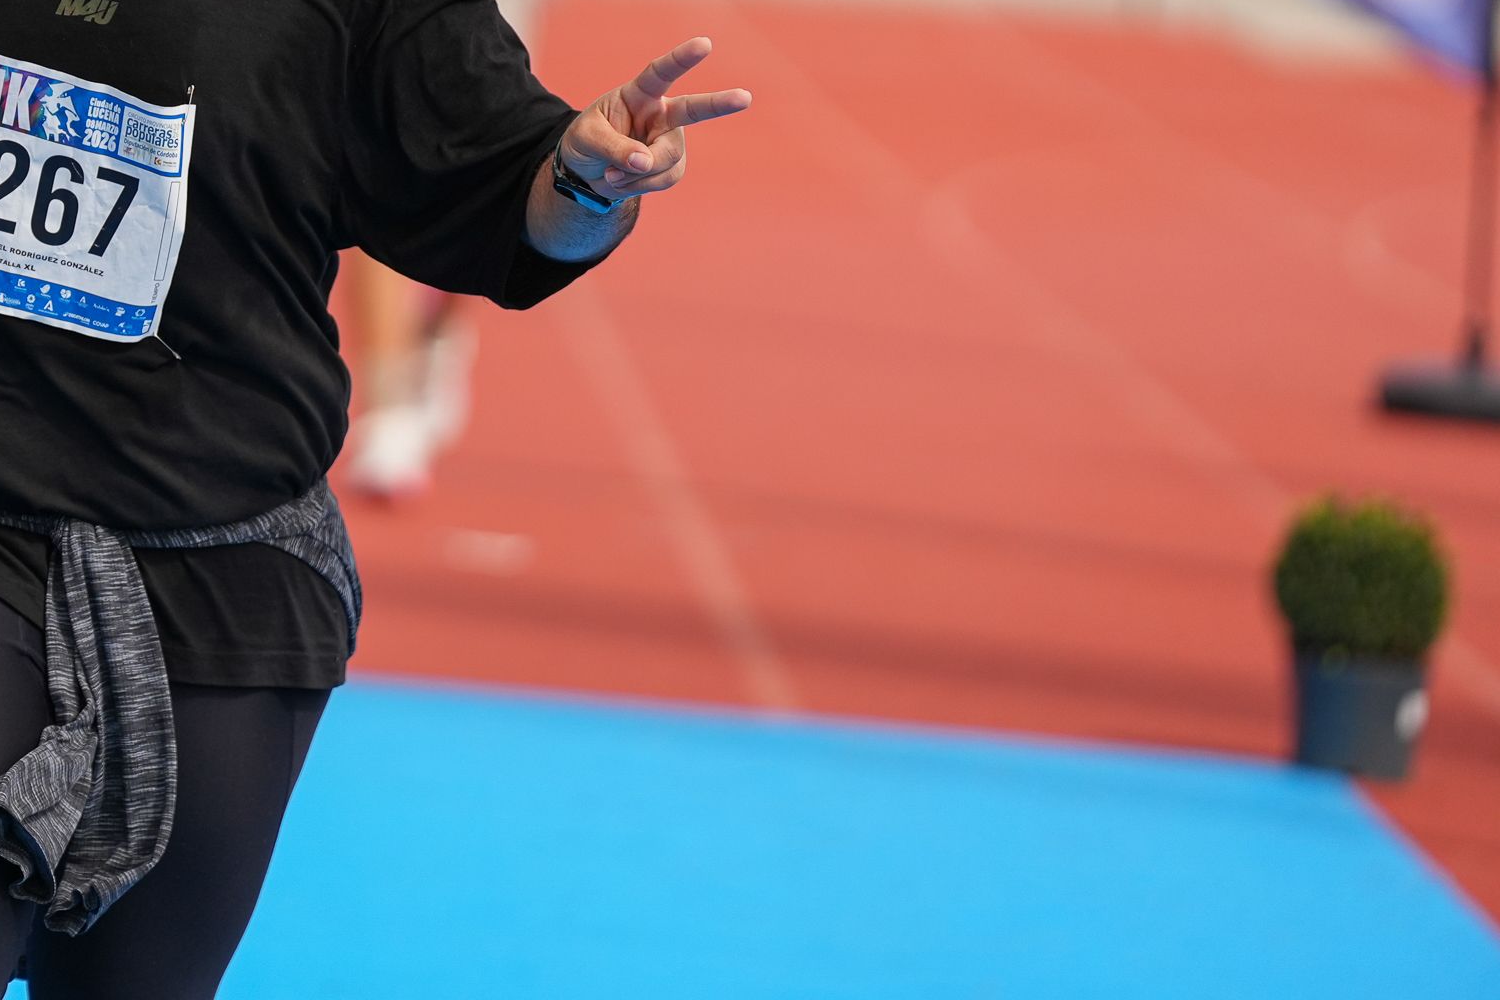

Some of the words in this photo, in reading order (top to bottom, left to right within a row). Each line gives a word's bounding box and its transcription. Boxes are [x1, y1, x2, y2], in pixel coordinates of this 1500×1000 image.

[87, 106, 120, 125] LUCENA
[90, 97, 112, 110] Ciudad
[113, 104, 121, 113] de
[125, 126, 179, 148] populares
[126, 117, 172, 139] carreras
[82, 129, 117, 152] 2026
[9, 246, 58, 264] RODRÍGUEZ
[60, 258, 104, 277] GONZÁLEZ
[23, 263, 36, 272] XL
